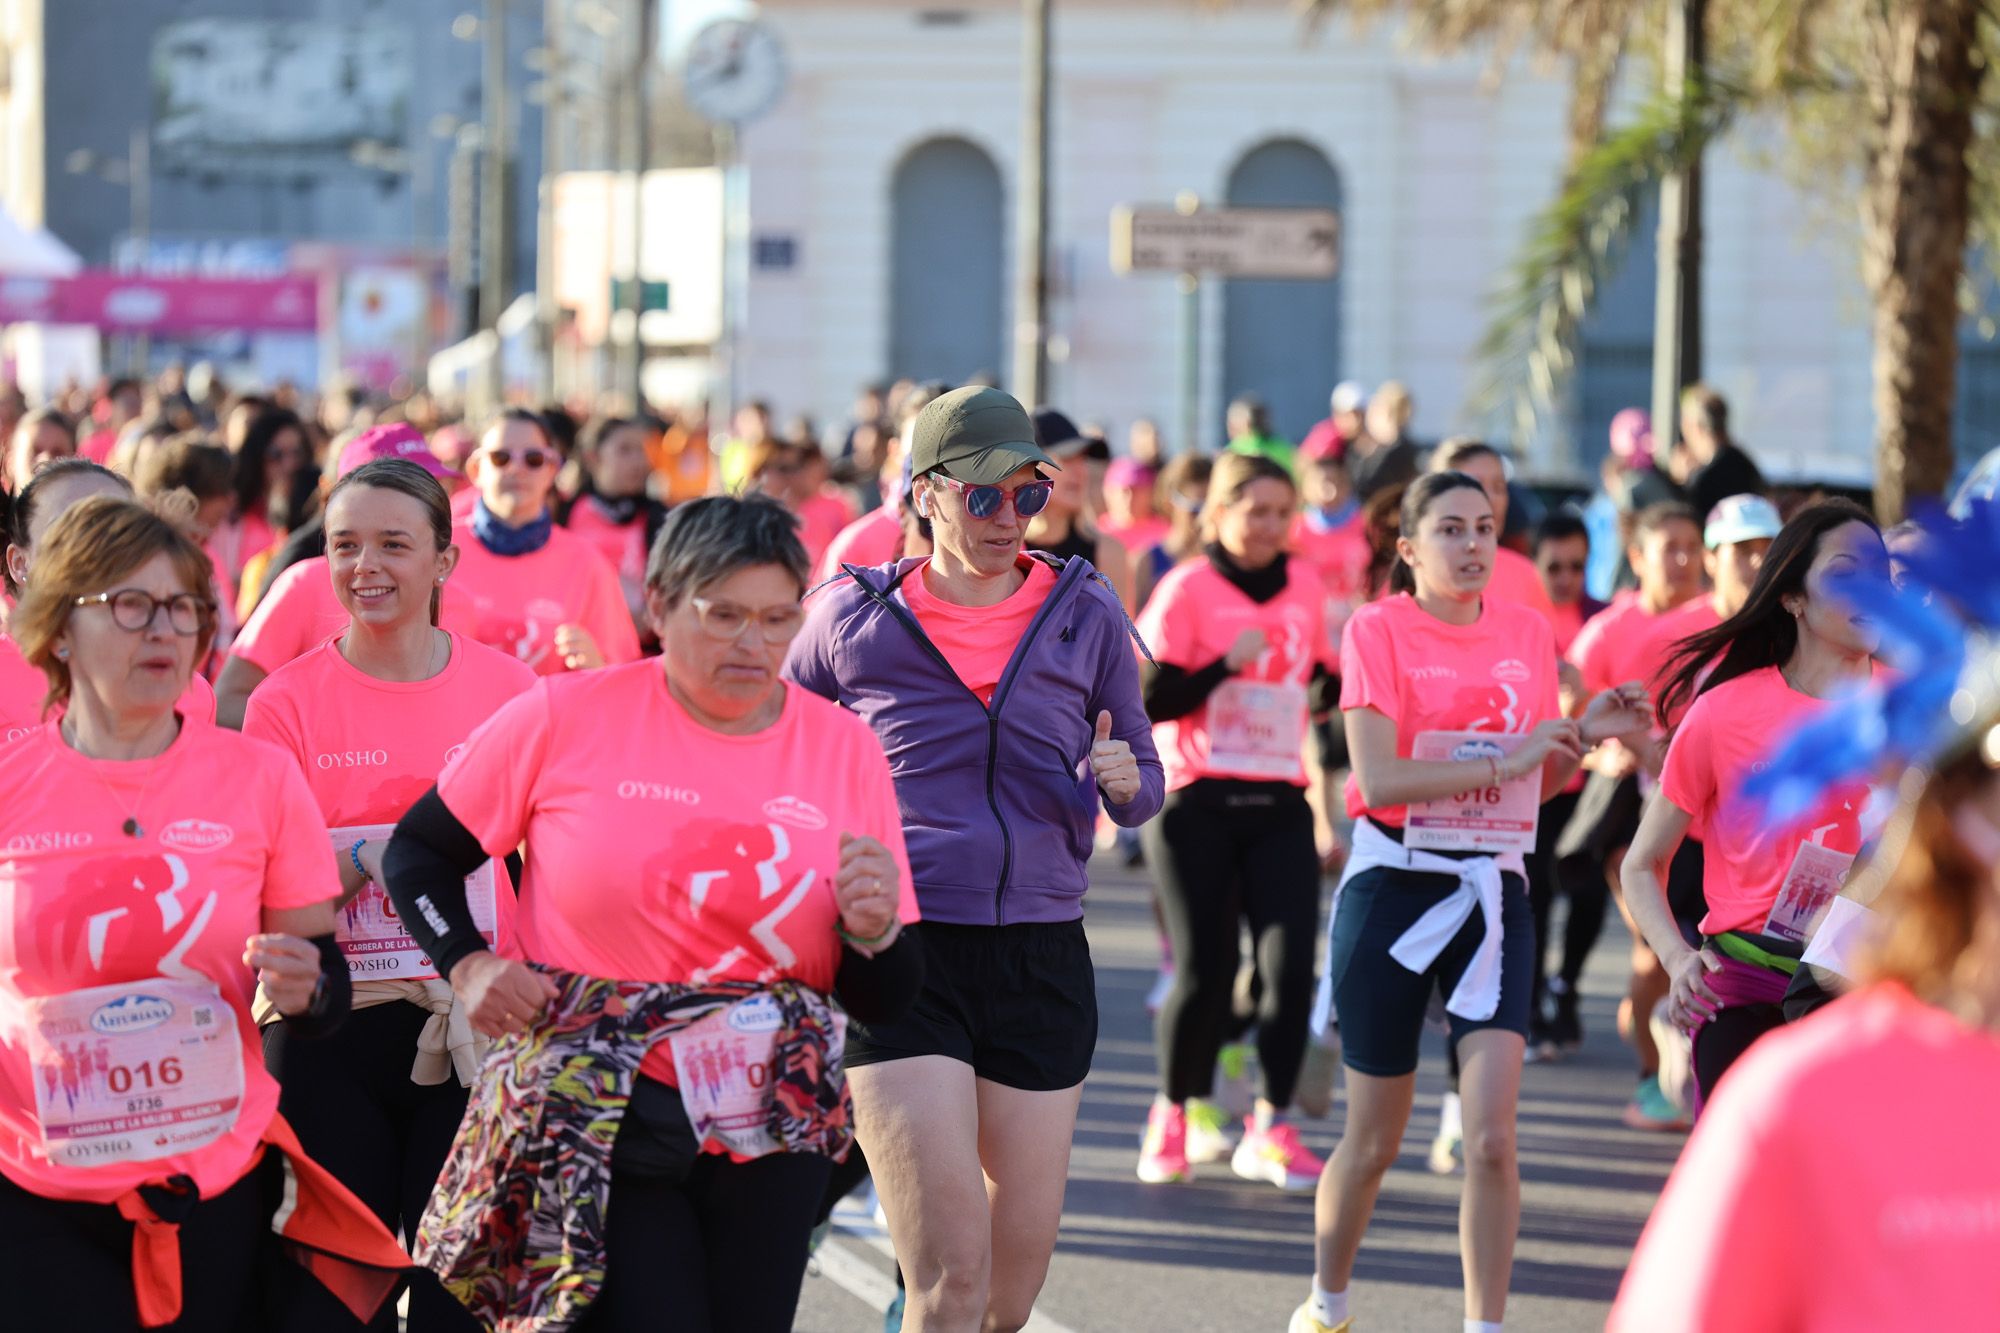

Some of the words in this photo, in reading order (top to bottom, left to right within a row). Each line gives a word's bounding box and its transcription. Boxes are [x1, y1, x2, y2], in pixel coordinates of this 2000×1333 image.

[317, 749, 388, 770] OYSHO
[617, 779, 700, 805] OYSHO
[8, 831, 93, 851] OYSHO
[348, 942, 383, 952] CARRERA
[385, 941, 396, 950] DE
[397, 940, 408, 949] LA
[349, 958, 399, 973] OYSHO
[108, 1056, 184, 1094] 016
[66, 1139, 132, 1158] OYSHO
